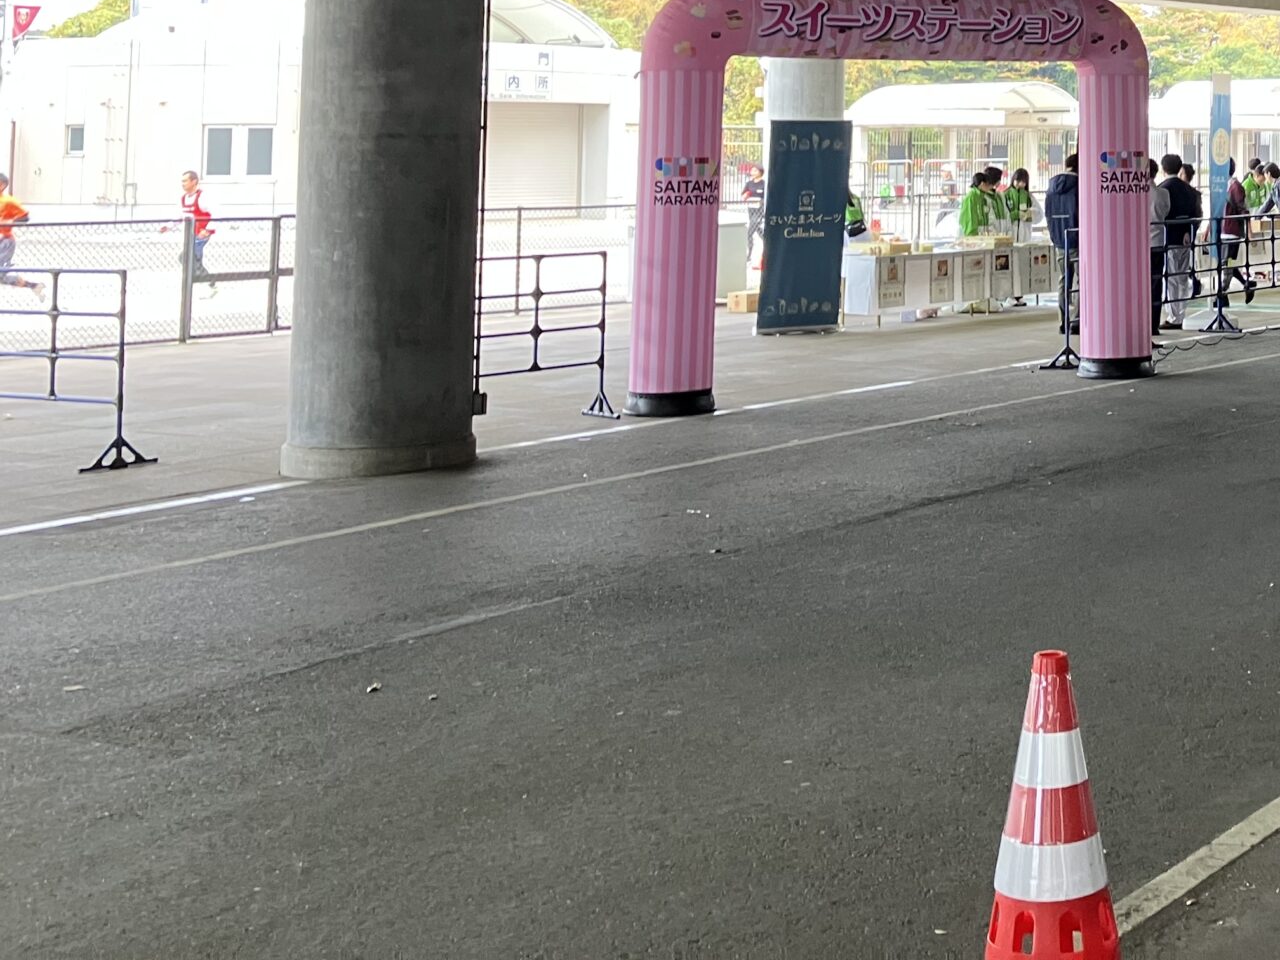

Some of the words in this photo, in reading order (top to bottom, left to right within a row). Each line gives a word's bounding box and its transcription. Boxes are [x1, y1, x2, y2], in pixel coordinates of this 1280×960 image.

[758, 0, 1083, 43] スイーツステーション
[1100, 184, 1150, 194] MARATHO
[769, 213, 842, 226] さいたまスイーツ
[783, 227, 825, 239] Collection
